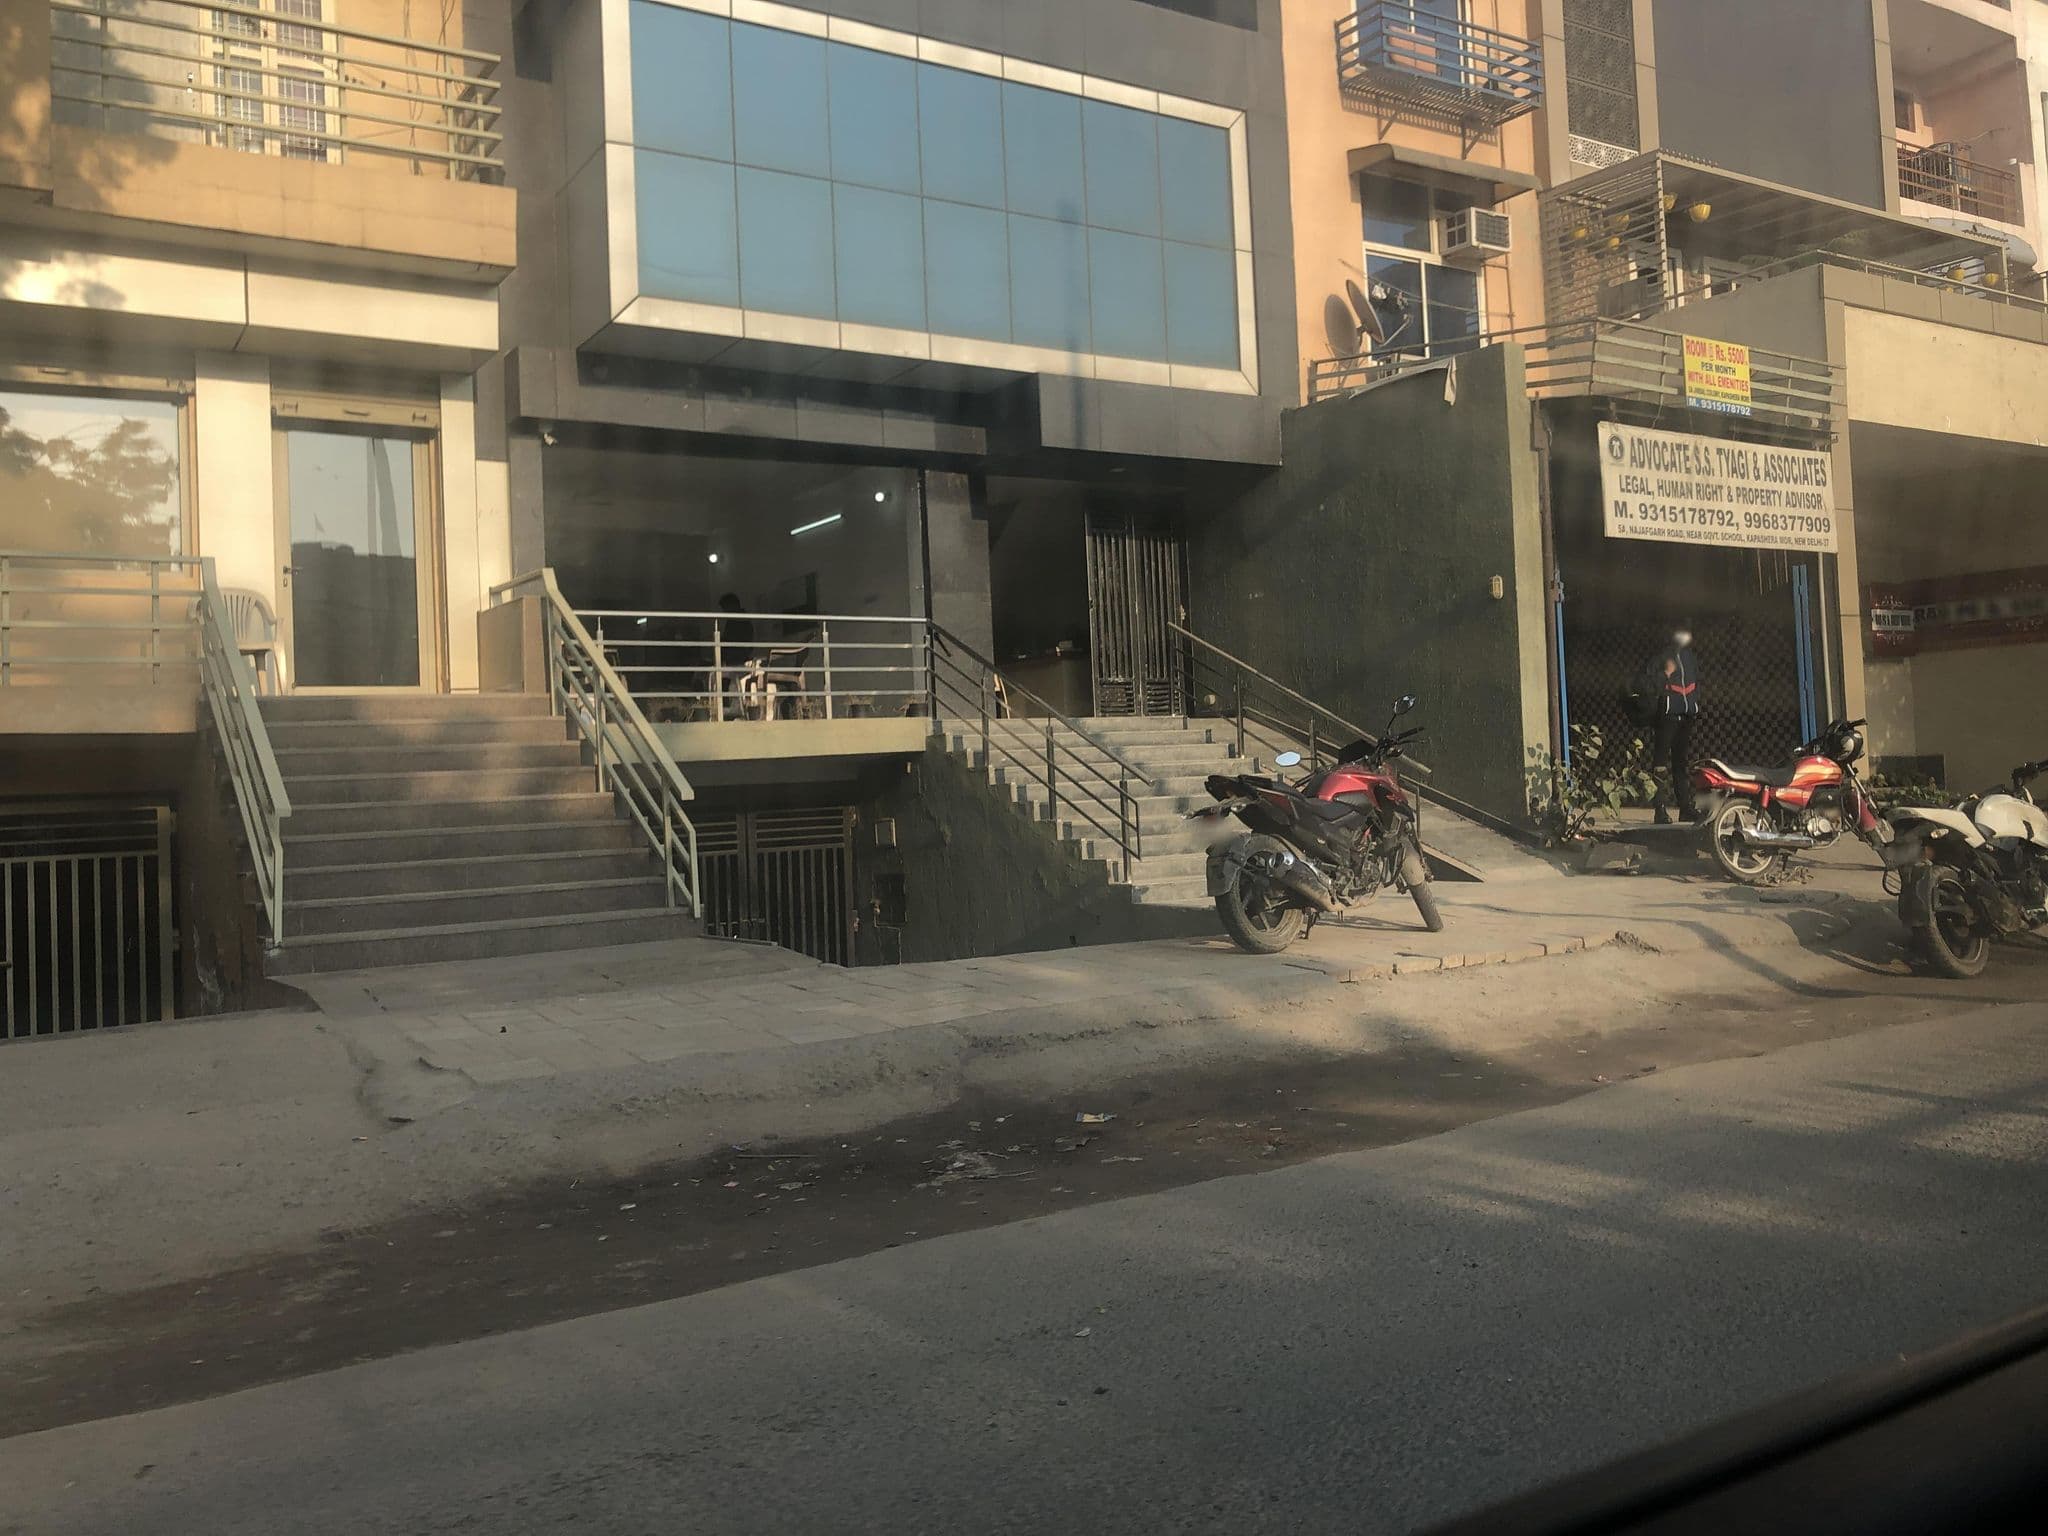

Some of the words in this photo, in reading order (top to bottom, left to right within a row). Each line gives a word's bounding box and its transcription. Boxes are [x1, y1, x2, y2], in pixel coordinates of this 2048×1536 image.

[1686, 339, 1707, 357] ROOM
[1716, 344, 1726, 361] Rs.
[1687, 370, 1703, 384] WITH
[1705, 373, 1716, 386] ALL
[1701, 362, 1713, 371] PER
[1715, 364, 1736, 376] MONTH
[1689, 397, 1699, 407] M.
[1701, 399, 1751, 416] 9315178792
[1630, 436, 1691, 474] ADVOCATE
[1693, 444, 1715, 477] S.S.
[1716, 448, 1749, 480] TYAGI
[1753, 451, 1761, 481] &
[1764, 453, 1827, 487] ASSOCIATES
[1619, 474, 1654, 499] LEGAL,
[1657, 479, 1693, 499] HUMAN
[1696, 482, 1723, 502] RIGHT
[1727, 485, 1733, 502] &
[1735, 487, 1782, 507] PROPERTY
[1614, 500, 1633, 519] M.
[1638, 502, 1739, 531] 9315178792,
[1744, 511, 1831, 533] 9968377909
[1629, 525, 1665, 537] NAJAFGARH
[1687, 531, 1702, 540] NEAR
[1794, 537, 1806, 546] NEW
